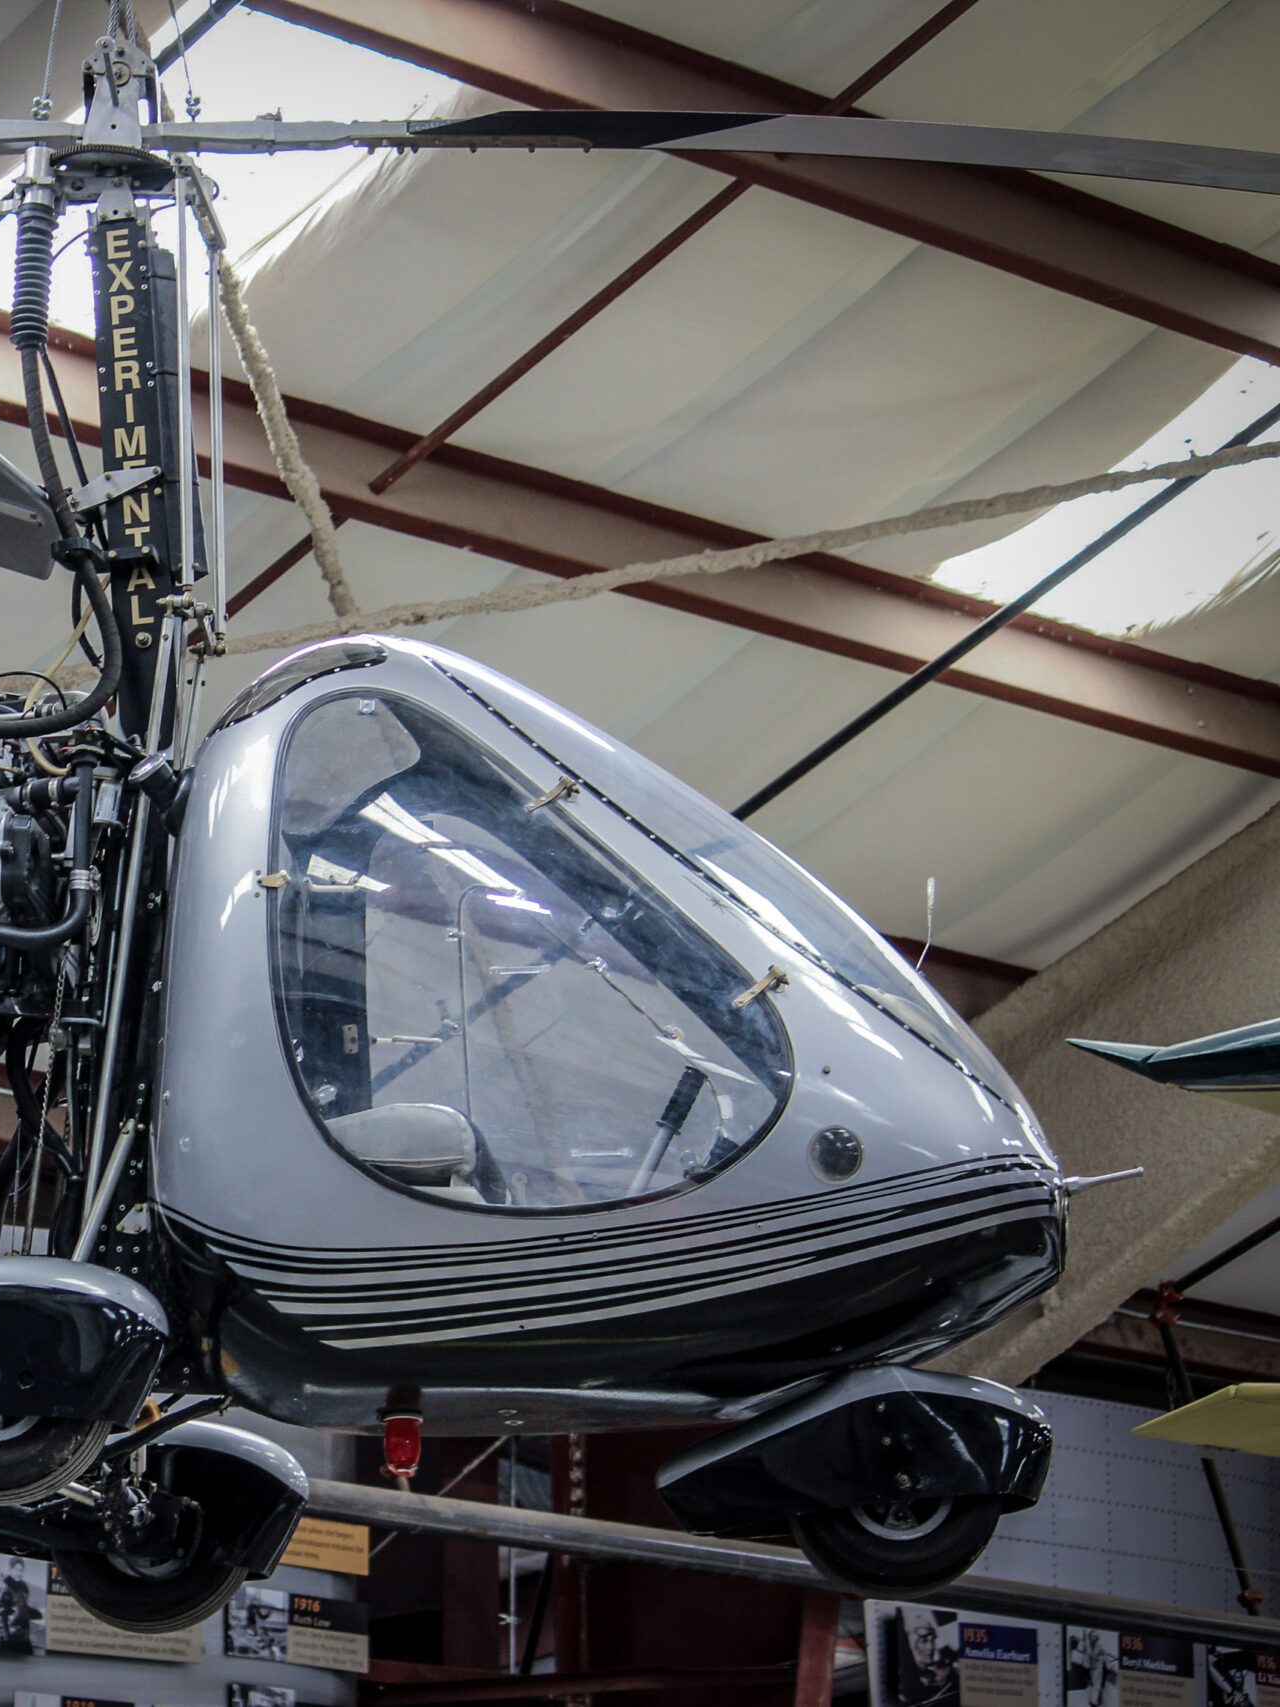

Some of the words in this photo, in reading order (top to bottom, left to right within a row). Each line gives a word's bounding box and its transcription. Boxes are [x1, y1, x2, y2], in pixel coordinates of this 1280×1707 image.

[105, 228, 154, 626] EXPERIMNTAL
[293, 1596, 320, 1613] 1916
[292, 1613, 312, 1625] Ruth
[963, 1626, 987, 1643] 1935
[1121, 1633, 1143, 1652] 1936
[963, 1645, 995, 1659] Amelia
[996, 1648, 1029, 1662] Earhart
